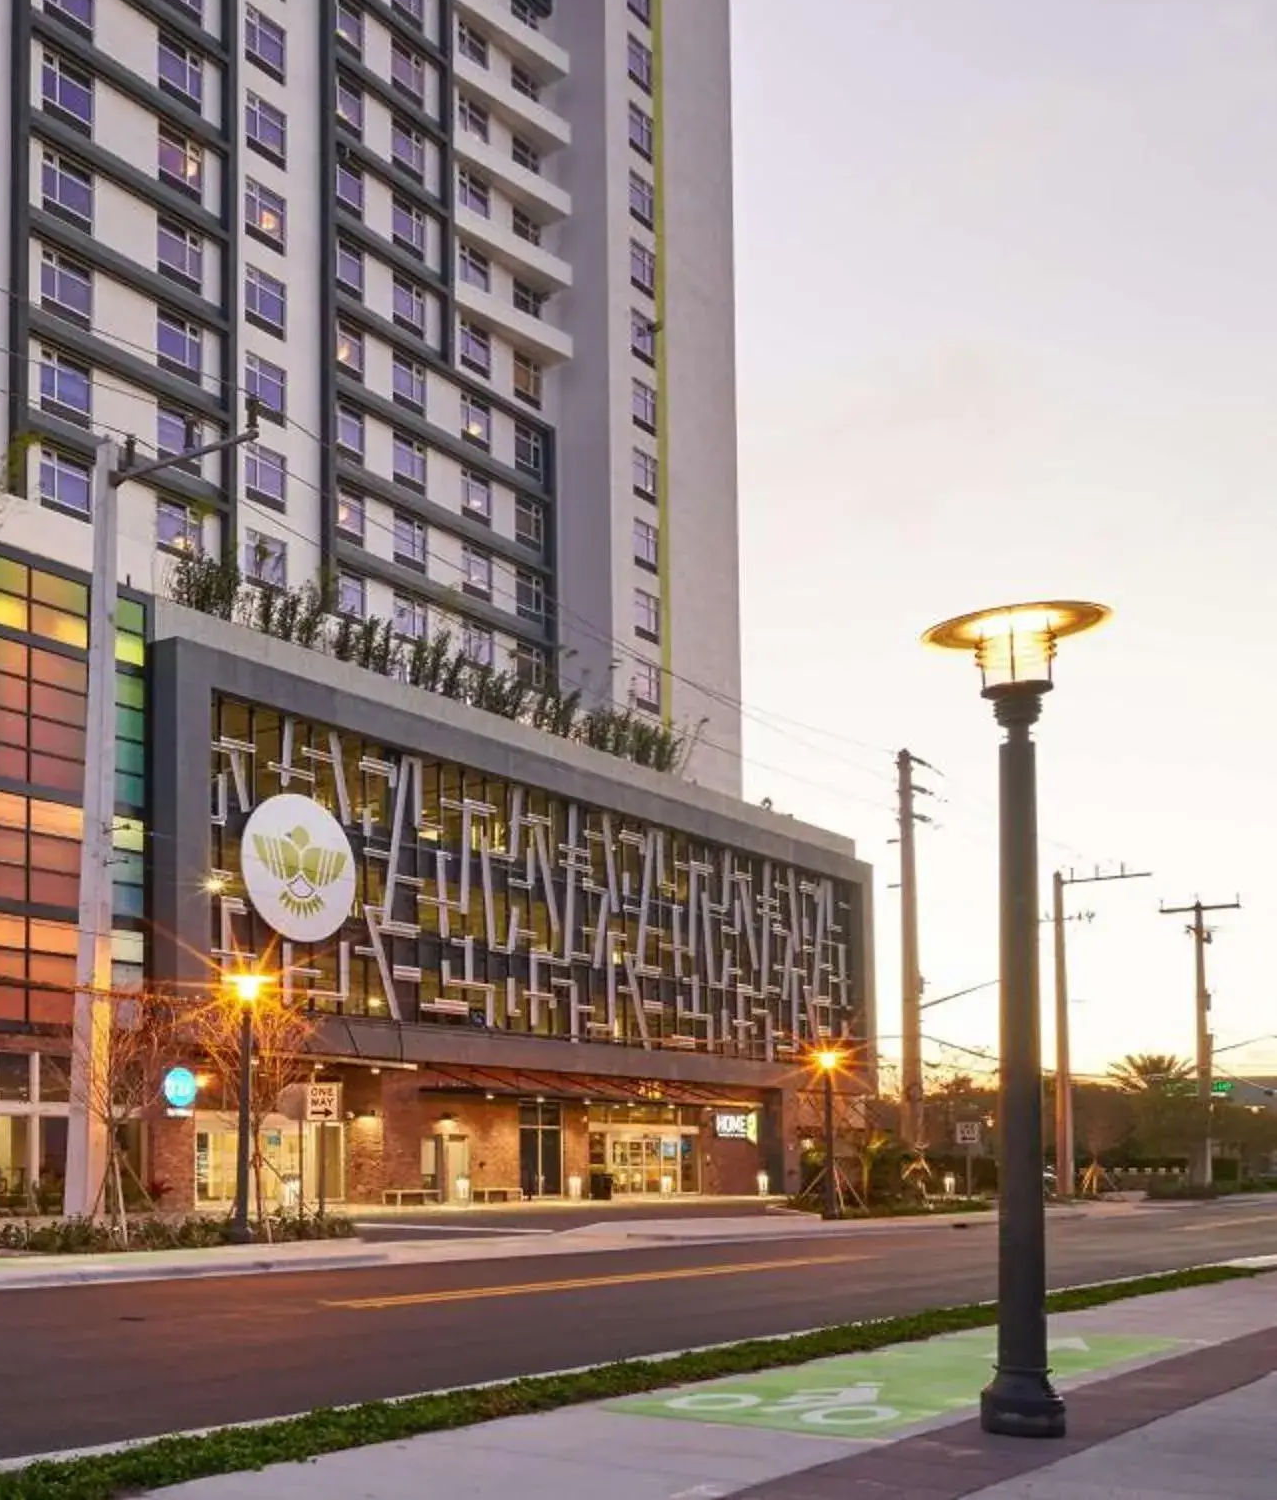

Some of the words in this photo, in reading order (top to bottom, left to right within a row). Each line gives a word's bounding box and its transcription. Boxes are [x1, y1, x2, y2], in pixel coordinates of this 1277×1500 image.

[310, 1087, 334, 1097] ONE
[311, 1098, 334, 1107] WAY
[716, 1115, 746, 1132] HOME
